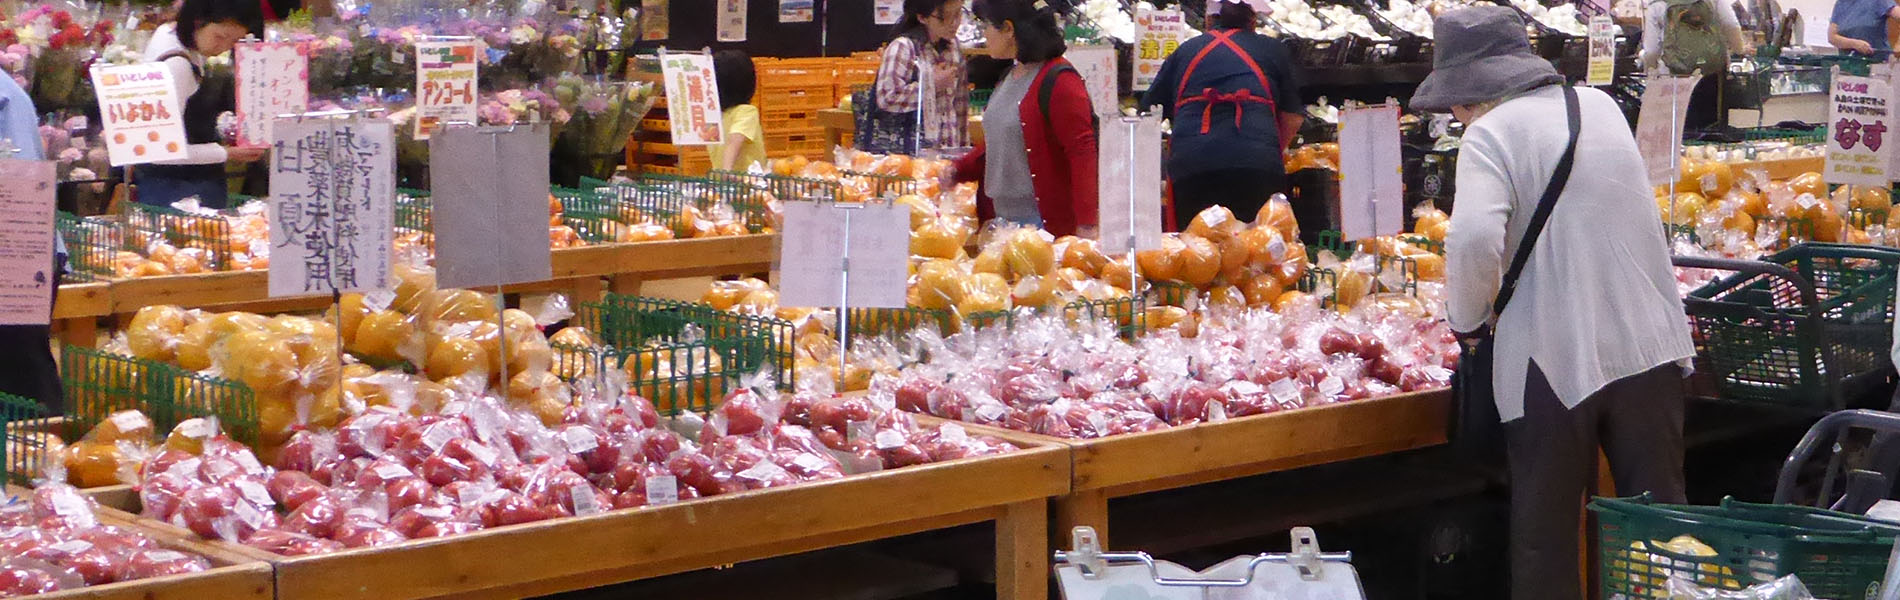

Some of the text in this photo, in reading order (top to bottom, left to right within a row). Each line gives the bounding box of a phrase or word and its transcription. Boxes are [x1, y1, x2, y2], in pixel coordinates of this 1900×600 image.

[1139, 39, 1179, 59] 清見
[422, 80, 473, 106] アンコール
[108, 100, 172, 124] いよかん
[1835, 118, 1887, 152] なす
